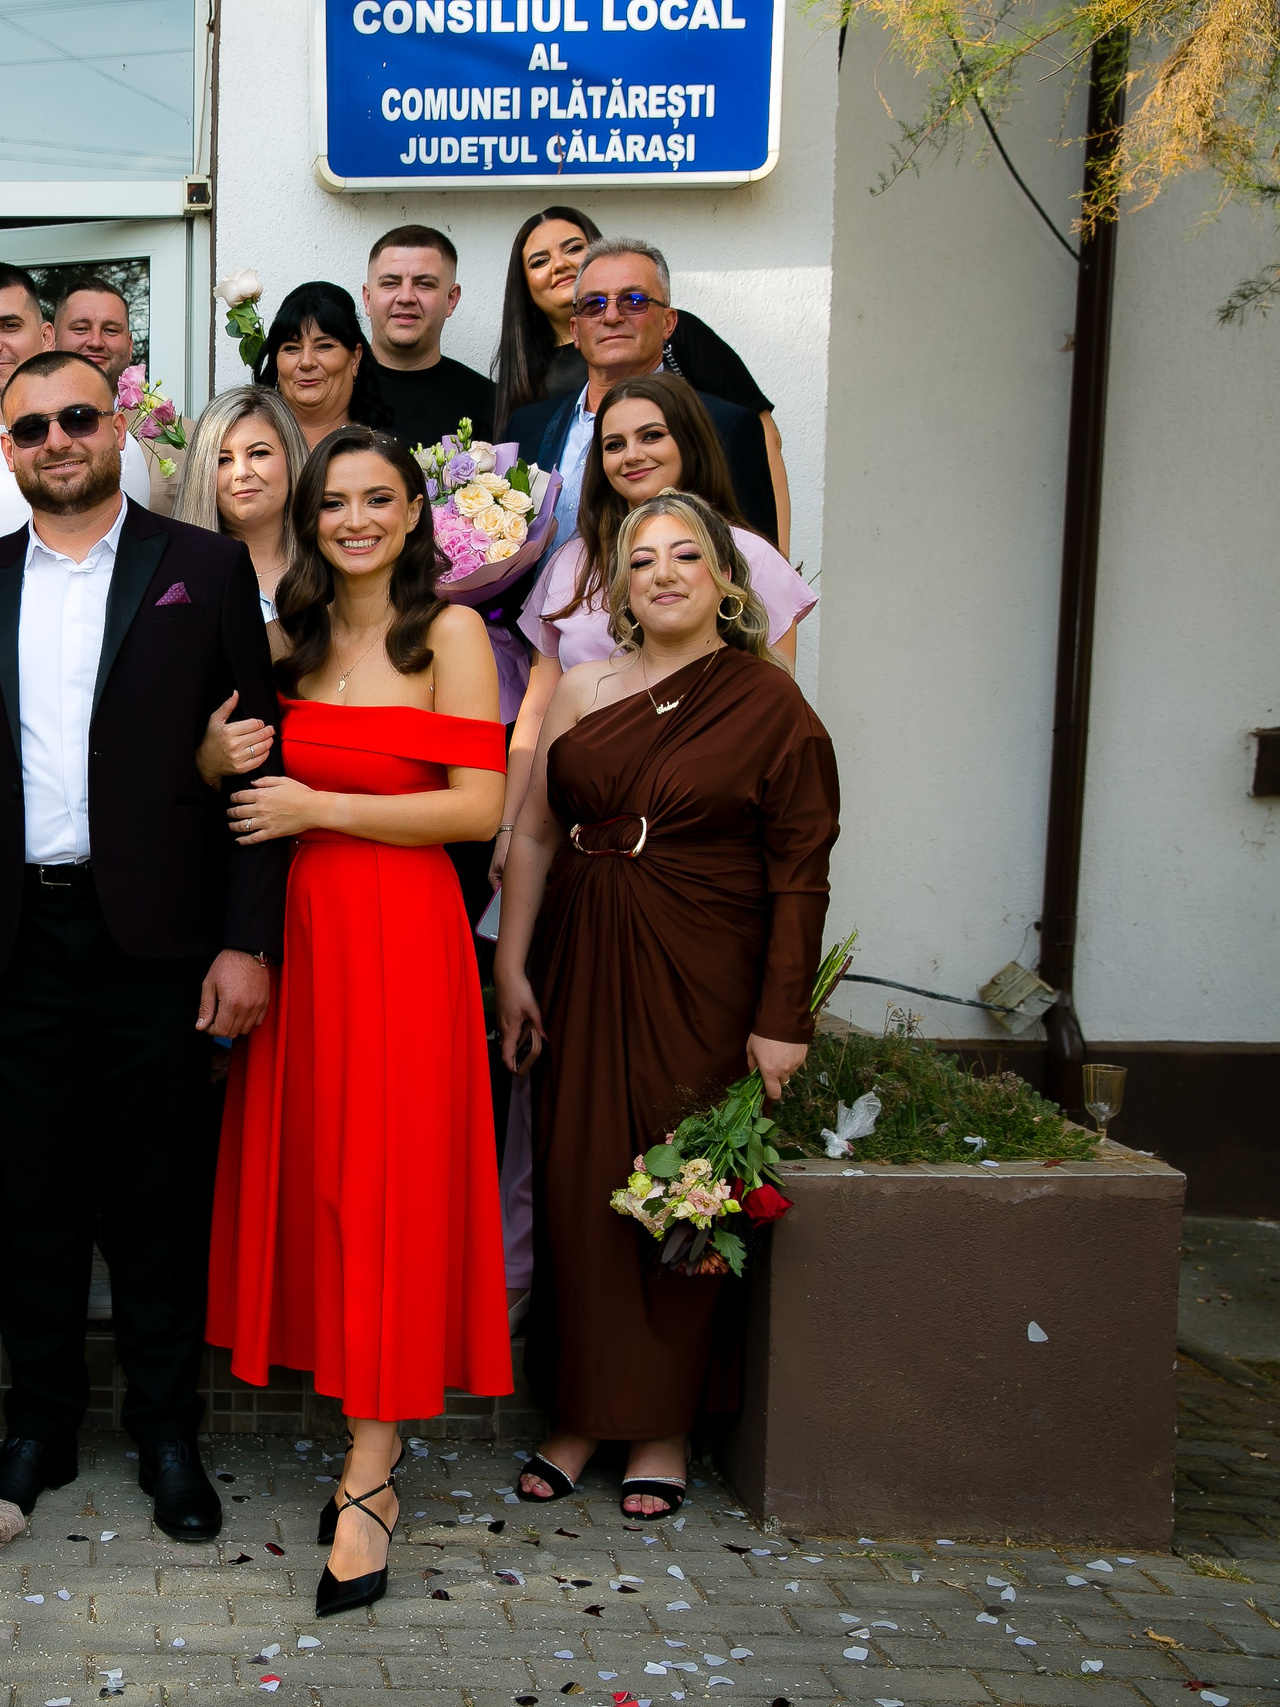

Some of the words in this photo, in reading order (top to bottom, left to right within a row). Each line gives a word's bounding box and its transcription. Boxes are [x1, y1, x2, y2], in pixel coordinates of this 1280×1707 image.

[353, 0, 589, 34] CONSILIUL
[602, 0, 746, 31] LOCAL
[528, 43, 568, 70] AL
[381, 87, 520, 121] COMUNEI
[531, 78, 715, 129] PLĂTĂREȘTI
[546, 128, 695, 171] CĂLĂRAȘI
